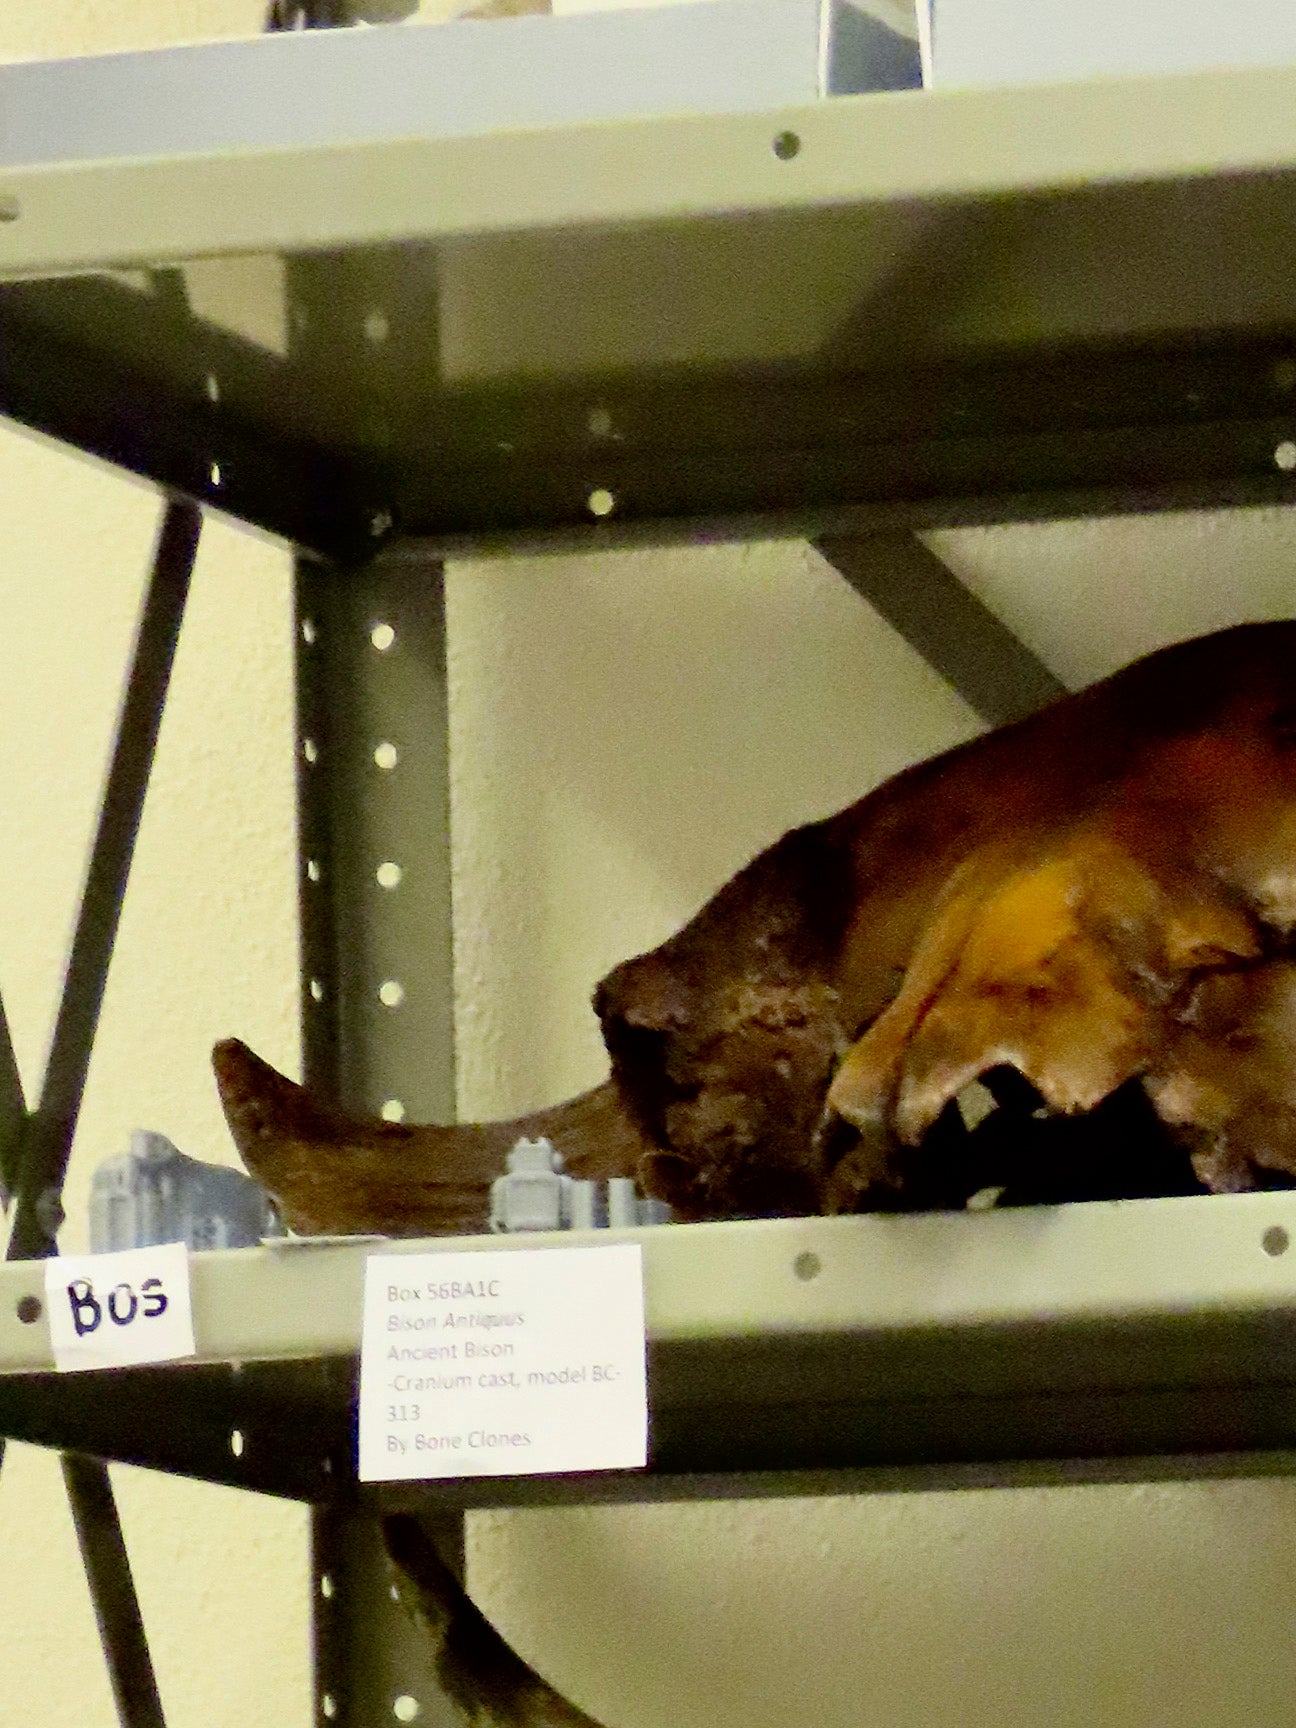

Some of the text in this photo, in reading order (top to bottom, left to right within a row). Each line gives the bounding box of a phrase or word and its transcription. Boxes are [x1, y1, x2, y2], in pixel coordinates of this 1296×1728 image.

[387, 1284, 421, 1302] Box
[387, 1314, 436, 1332] Bison
[387, 1341, 514, 1361] Ancient Bison
[387, 1374, 472, 1392] -Cranium
[479, 1371, 521, 1389] cast,
[528, 1367, 586, 1386] model
[387, 1404, 421, 1422] 313
[387, 1430, 532, 1454] By Bone Clones
